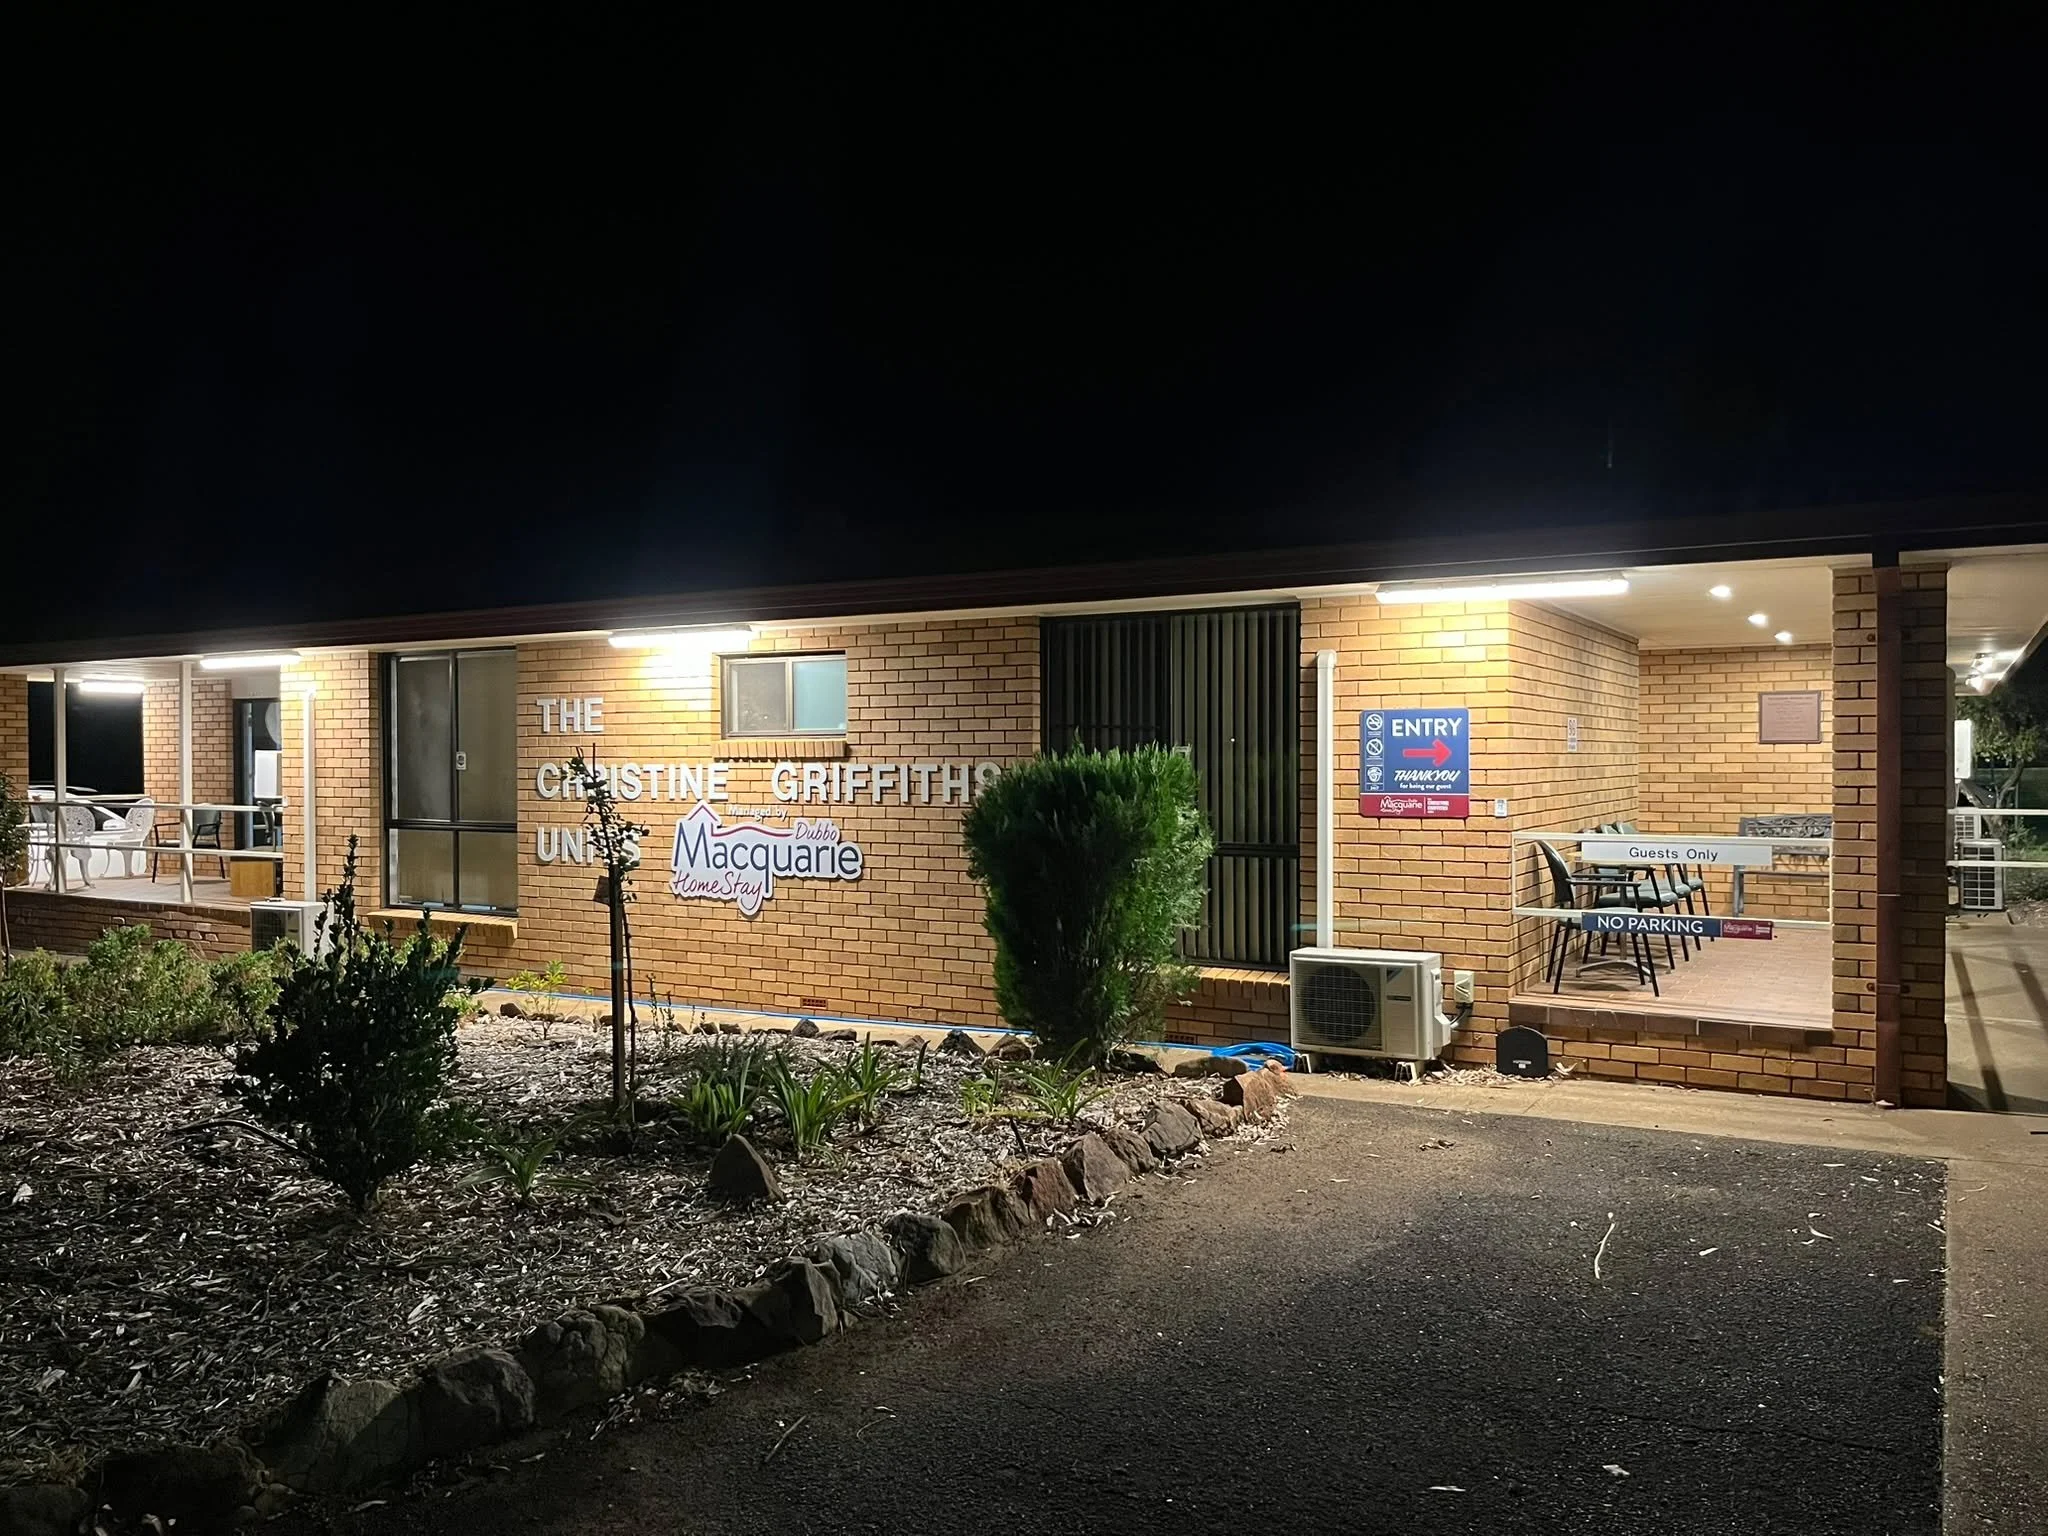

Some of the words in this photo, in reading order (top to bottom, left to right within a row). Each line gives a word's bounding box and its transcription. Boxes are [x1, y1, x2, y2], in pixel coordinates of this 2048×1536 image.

[536, 697, 604, 733] THE
[1391, 717, 1463, 737] ENTRY
[728, 804, 773, 822] Managed
[776, 806, 788, 820] by
[795, 821, 838, 841] Dubbo
[673, 822, 860, 894] Macquarie
[1629, 847, 1679, 859] Guests
[1686, 848, 1719, 862] Only
[673, 871, 763, 911] HomeStay
[1597, 915, 1624, 930] NO
[1628, 917, 1704, 934] PARKING
